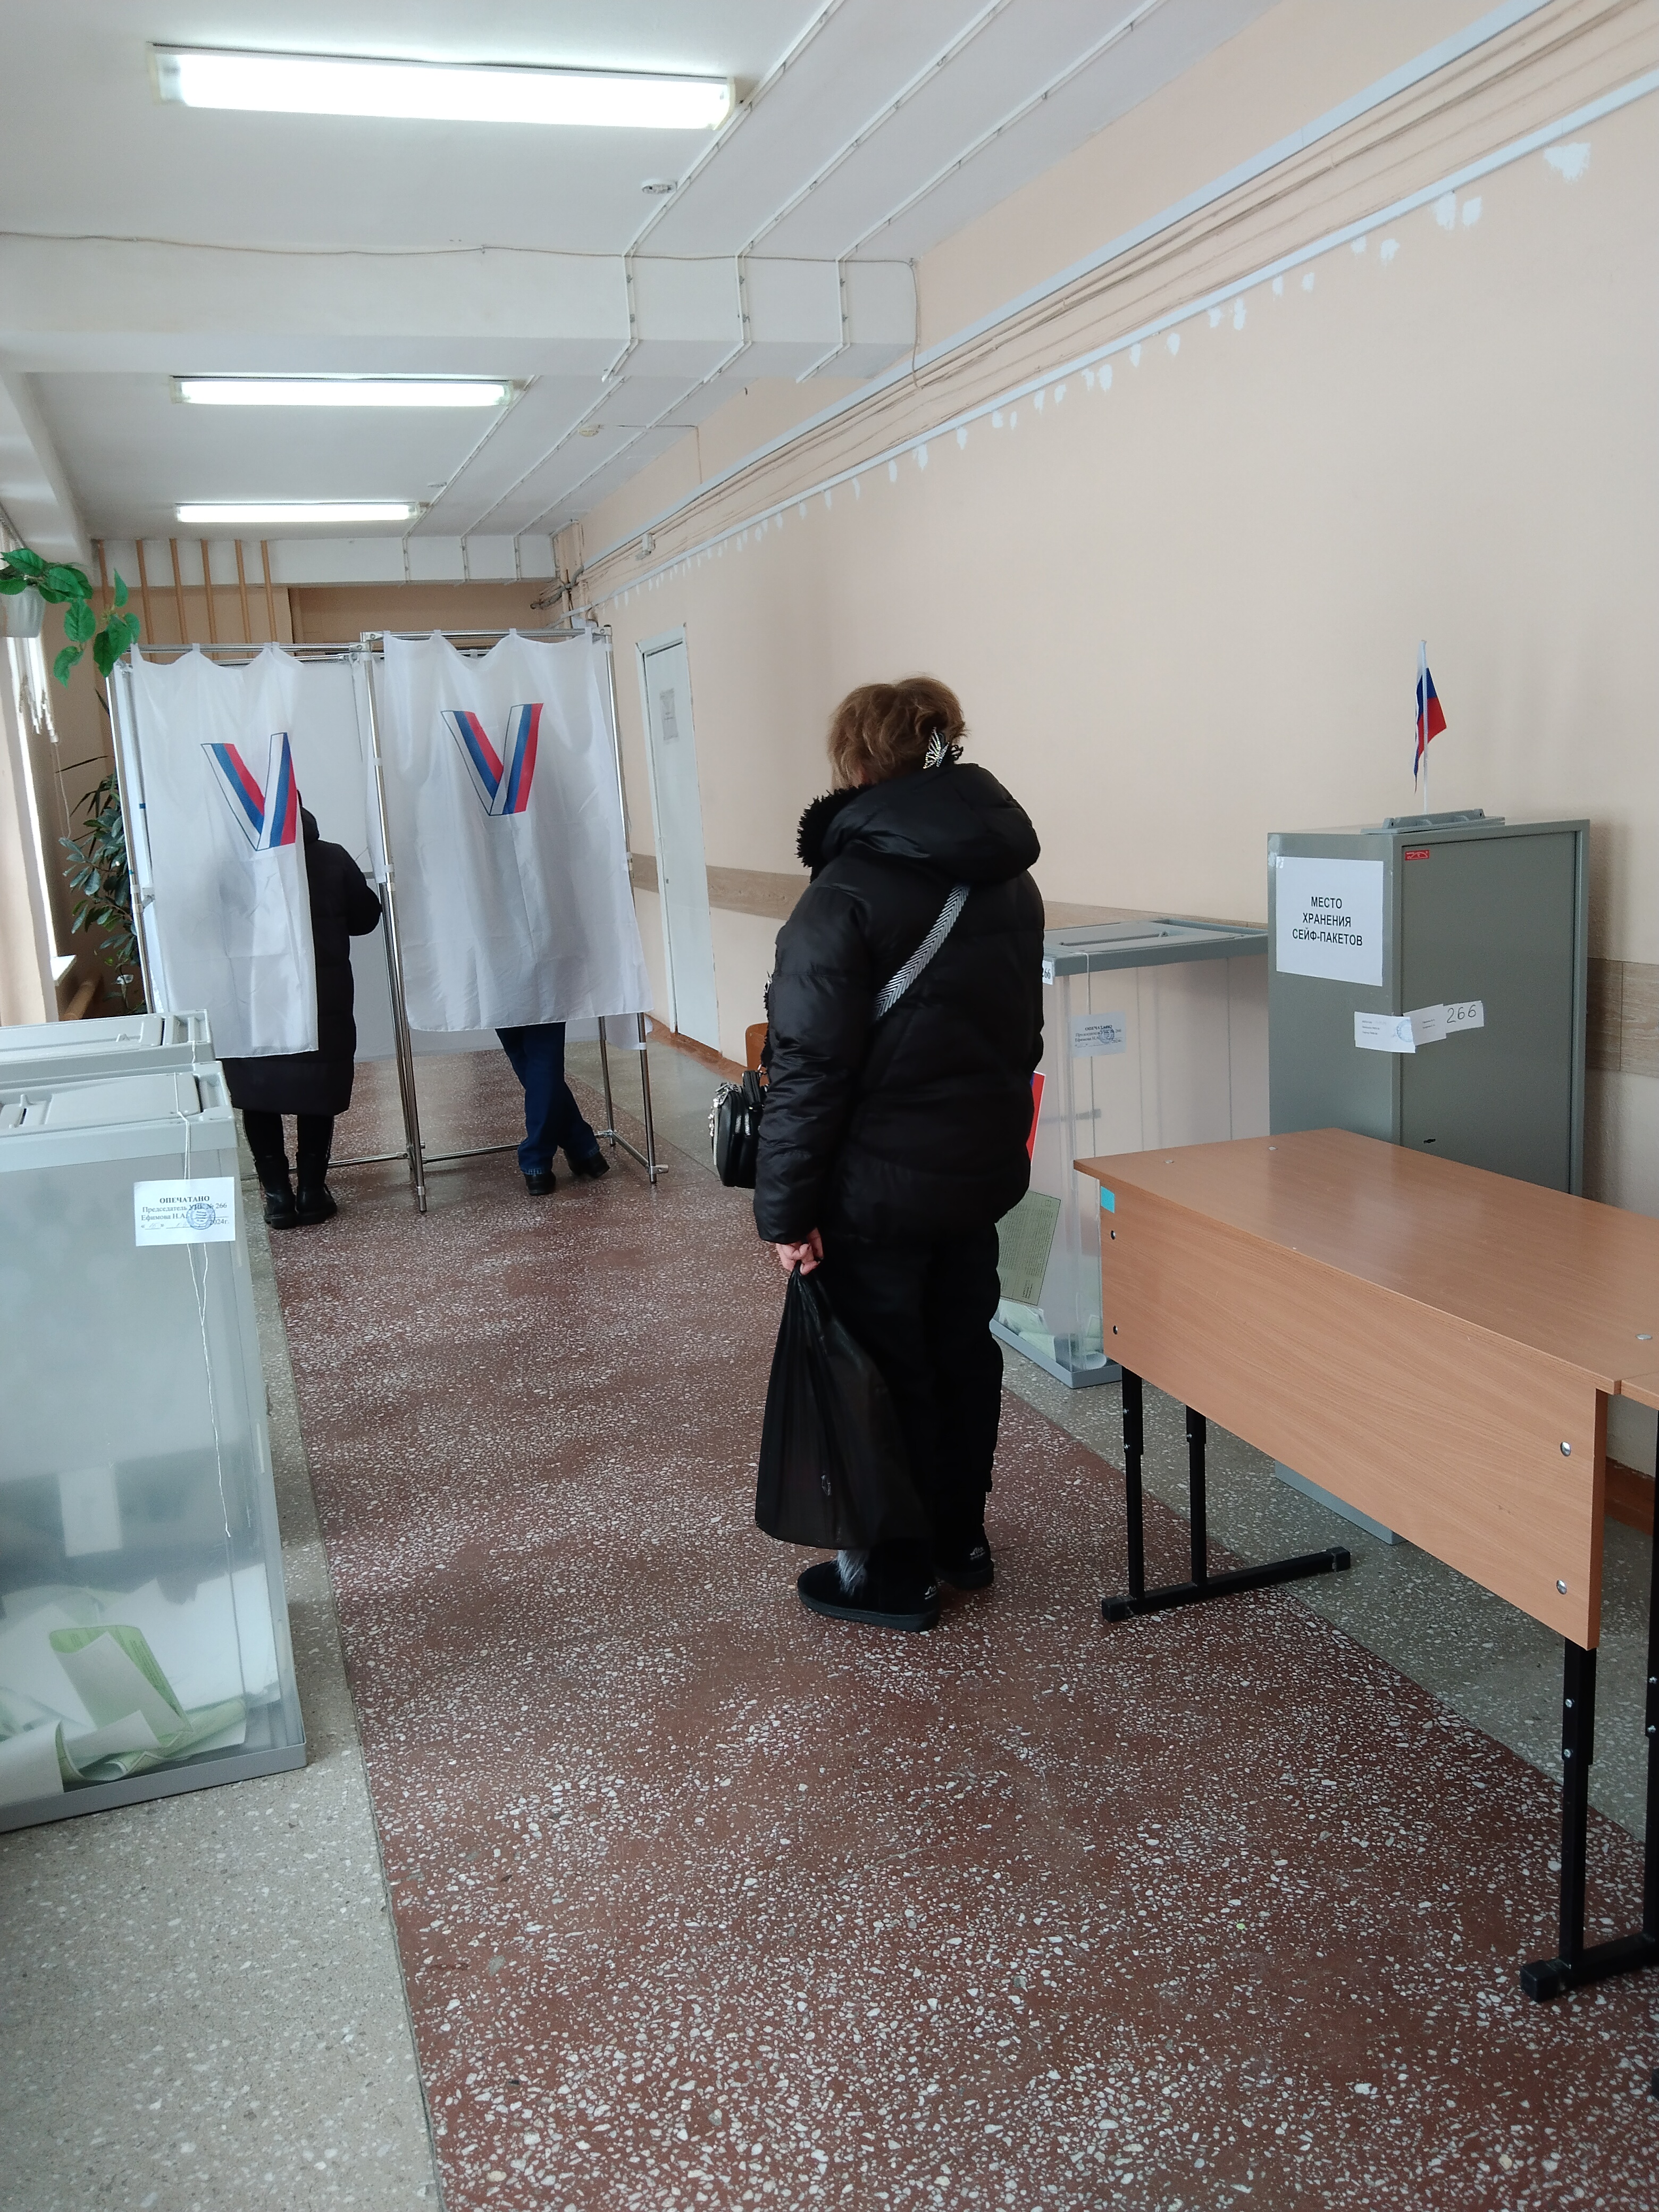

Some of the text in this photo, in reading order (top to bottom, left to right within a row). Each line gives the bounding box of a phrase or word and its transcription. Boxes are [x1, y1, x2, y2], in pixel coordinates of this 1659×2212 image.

[1311, 896, 1343, 909] МЕСТО
[1302, 912, 1352, 927] ХРАНЕНИЯ
[1292, 927, 1363, 946] СЕЙФ-ПАКЕТОВ
[1042, 968, 1051, 979] 66
[1446, 1004, 1477, 1024] 266
[160, 1195, 210, 1204] ОПЕЧАТАНО
